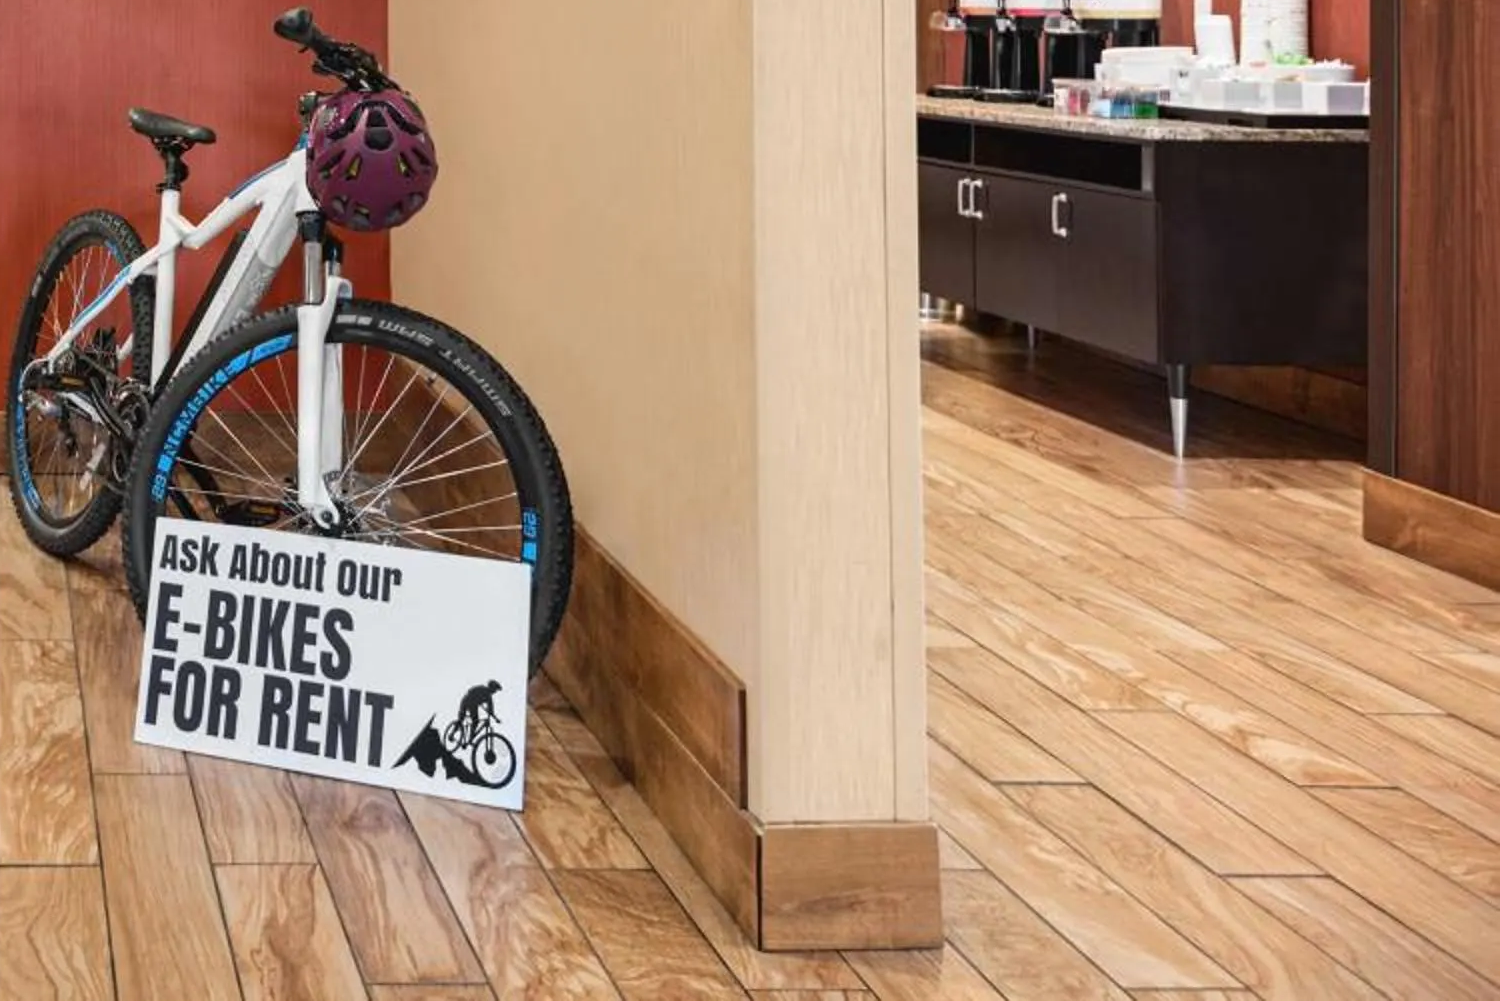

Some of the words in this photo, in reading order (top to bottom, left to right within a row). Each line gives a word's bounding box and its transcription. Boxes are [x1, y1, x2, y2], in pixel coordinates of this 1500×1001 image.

[160, 534, 219, 576] Ask
[229, 542, 326, 593] About
[337, 557, 402, 602] Our
[153, 581, 354, 681] E-BIKES
[144, 654, 242, 740] FOR
[257, 673, 394, 768] RENT
